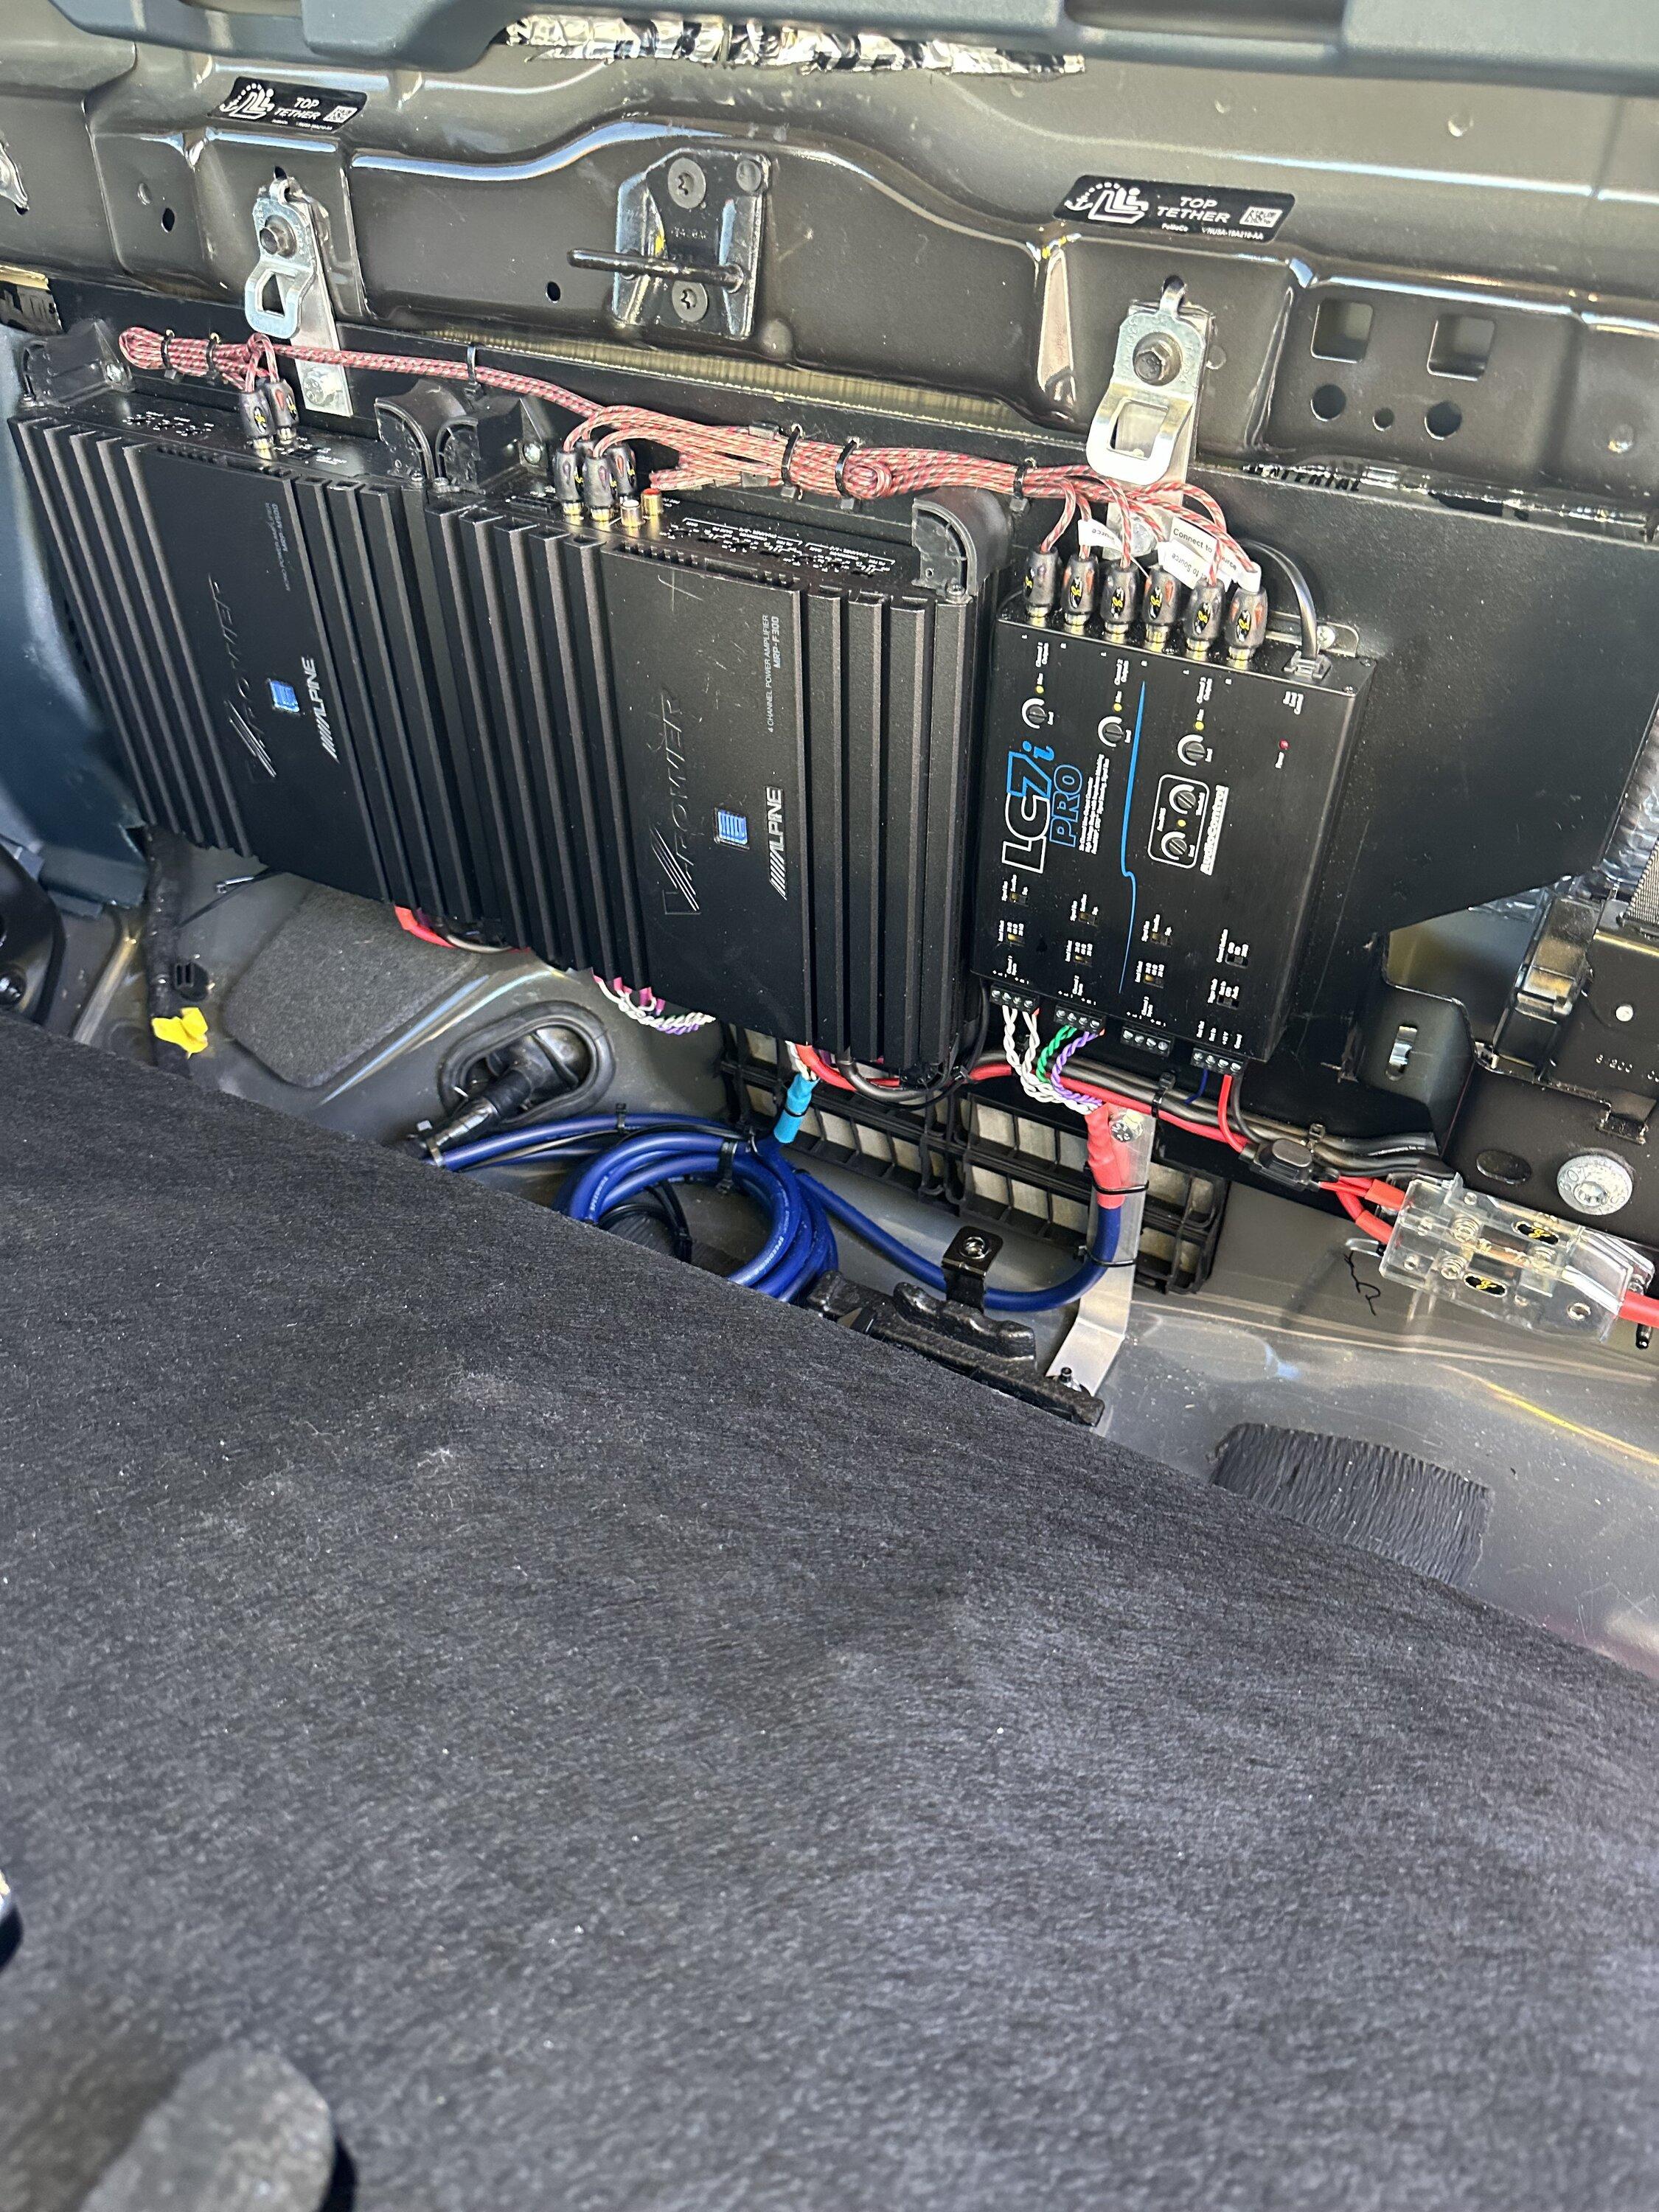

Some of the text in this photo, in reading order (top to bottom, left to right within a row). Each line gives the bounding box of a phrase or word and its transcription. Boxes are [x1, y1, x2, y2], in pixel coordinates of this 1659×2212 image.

[274, 107, 321, 119] TETHER
[294, 97, 319, 109] TOP
[1157, 206, 1231, 223] TETHER
[1180, 196, 1218, 209] TOP
[1172, 528, 1204, 549] Connect
[1206, 544, 1213, 553] to
[1172, 552, 1192, 573] Source
[762, 614, 772, 658] AMPLIFIER
[771, 616, 781, 669] MRP-F300
[764, 658, 772, 689] POWER
[302, 655, 340, 764] ALPINE
[766, 689, 774, 727] CHANNEL
[1002, 740, 1054, 874] LC7i
[1049, 765, 1082, 847] PRO
[765, 786, 787, 901] ALPINE
[1200, 785, 1227, 874] AudioControl
